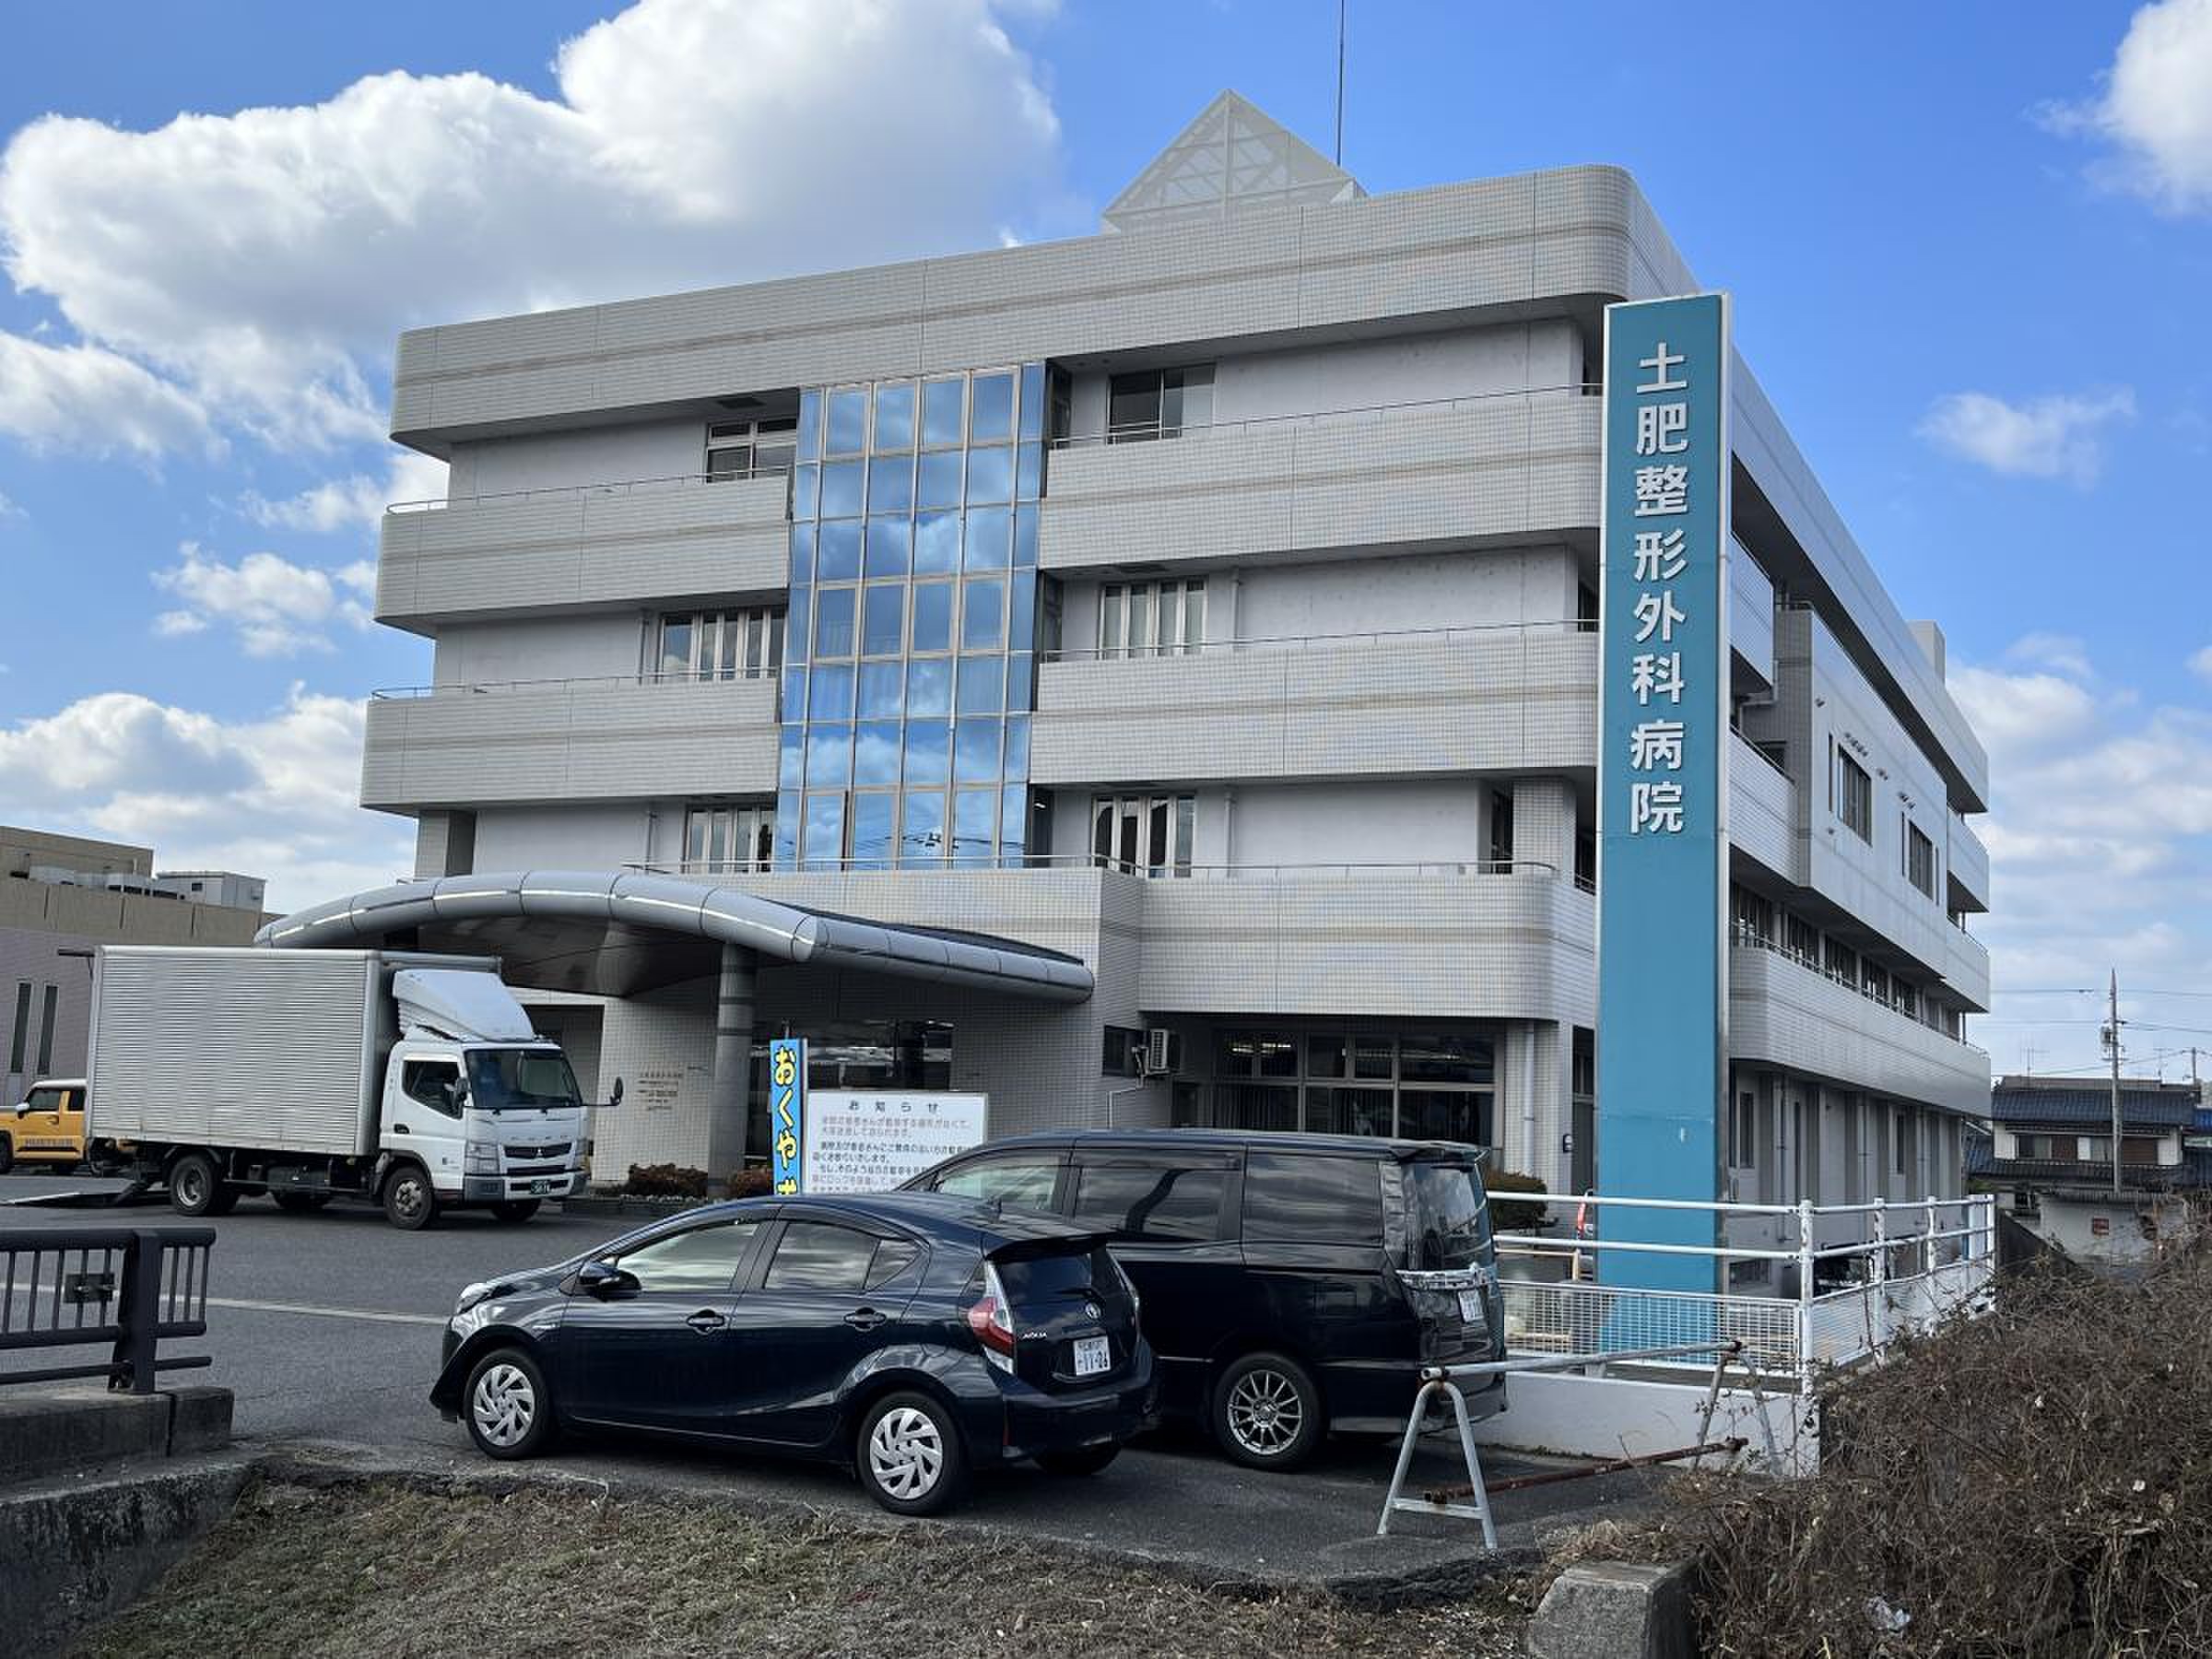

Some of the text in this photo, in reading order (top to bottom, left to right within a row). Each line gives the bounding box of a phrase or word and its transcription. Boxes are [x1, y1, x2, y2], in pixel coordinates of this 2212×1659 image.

[1630, 342, 1688, 834] 土肥整形外科病院
[849, 1100, 938, 1113] お知らせ
